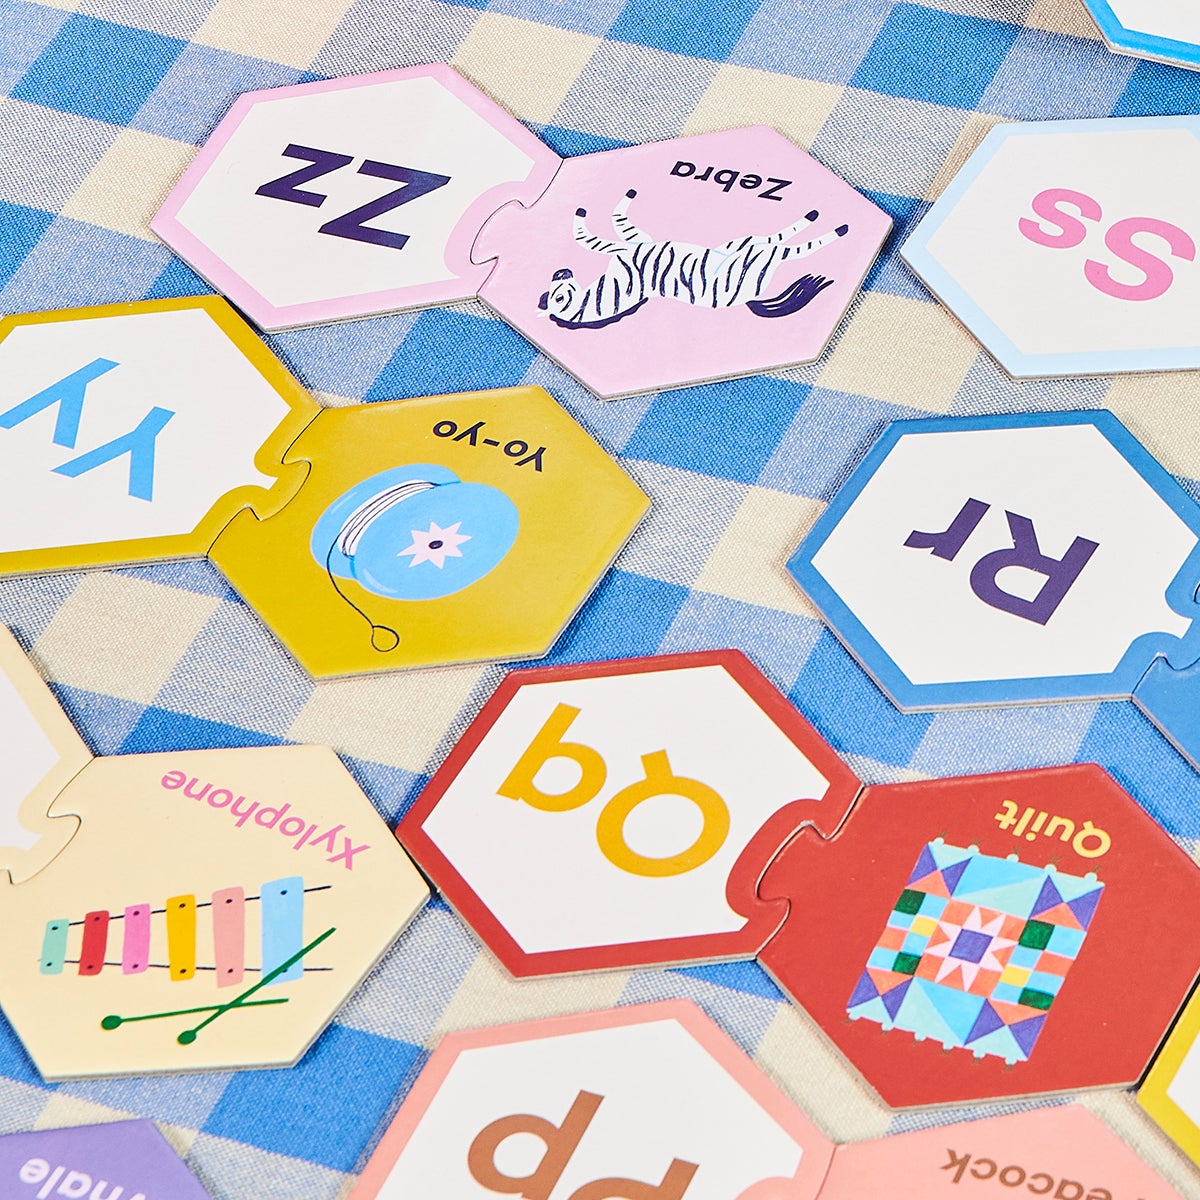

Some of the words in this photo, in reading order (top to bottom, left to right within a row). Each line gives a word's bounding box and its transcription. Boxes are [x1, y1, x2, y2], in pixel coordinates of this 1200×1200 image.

[255, 144, 452, 250] Zz
[670, 160, 793, 202] Zebra
[1018, 188, 1196, 302] Ss
[0, 358, 175, 503] Yy
[433, 420, 547, 473] Yo-yo
[903, 497, 1100, 627] Rr
[160, 769, 372, 871] Xylophone
[496, 702, 731, 878] Qq
[995, 799, 1112, 860] Quilt
[939, 1148, 1145, 1200] eacock
